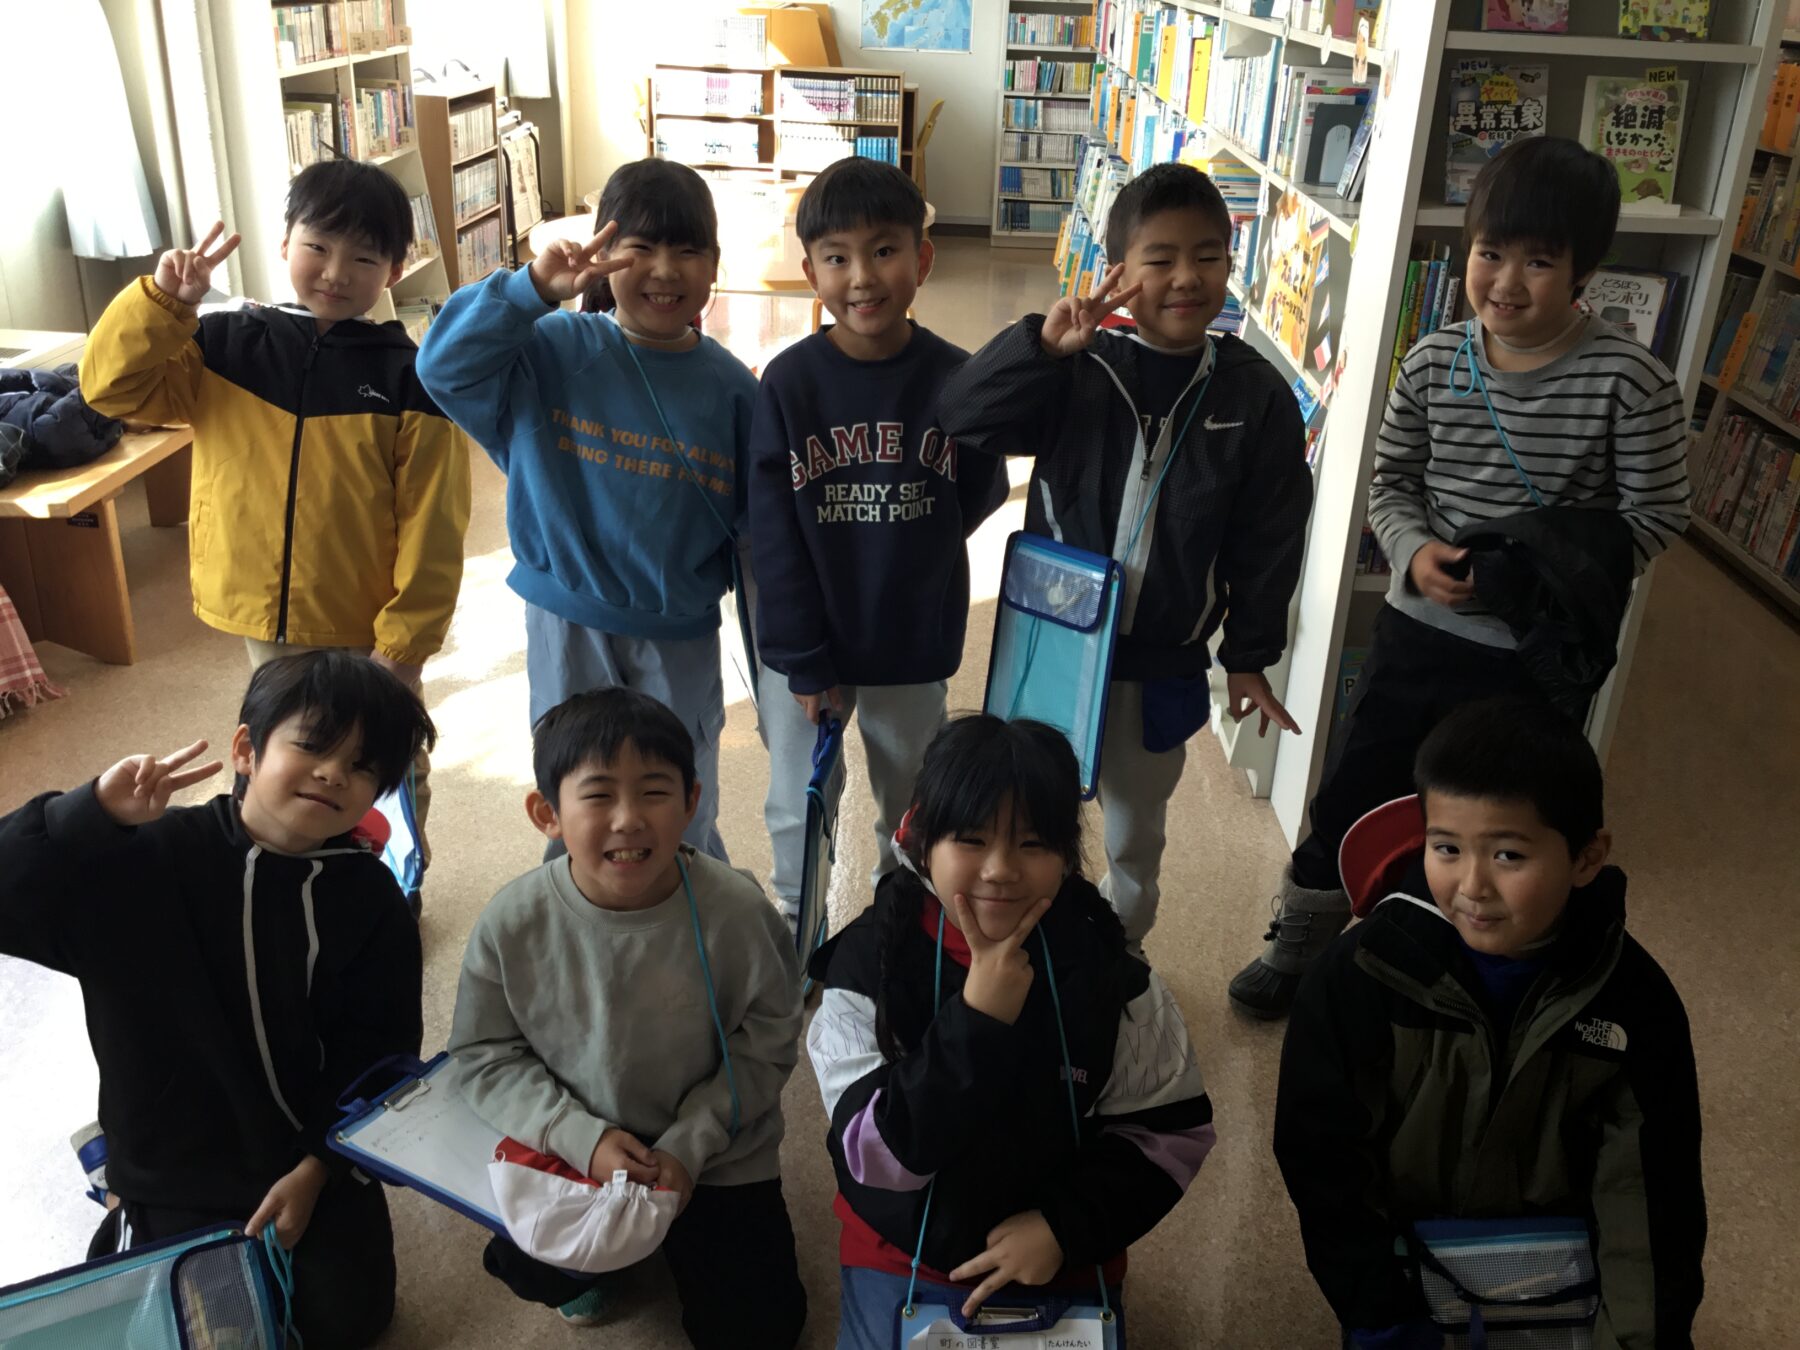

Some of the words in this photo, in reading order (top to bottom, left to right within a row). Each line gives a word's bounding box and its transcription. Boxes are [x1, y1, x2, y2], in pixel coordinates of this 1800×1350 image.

[1461, 60, 1488, 71] NEW
[1649, 70, 1676, 82] NEW
[1454, 98, 1543, 130] 異常気象
[1611, 103, 1666, 130] 絶滅
[1605, 131, 1666, 147] しなかった
[1601, 278, 1641, 290] どろぼう
[551, 408, 606, 438] THANK
[610, 427, 648, 448] YOU
[651, 436, 686, 454] FOR
[686, 445, 736, 473] ALWAY
[790, 422, 904, 491] GAME
[614, 454, 673, 479] THERE
[708, 476, 733, 497] ME
[824, 484, 892, 502] READY
[900, 480, 928, 501] SET
[816, 503, 882, 523] MATCH
[888, 497, 936, 523] POINT
[1575, 1021, 1610, 1040] NORTH
[1592, 1017, 1612, 1031] THE
[1582, 1032, 1608, 1047] FACE
[939, 1336, 1000, 1350] 町の図書室
[1047, 1339, 1092, 1348] たんけんたい
